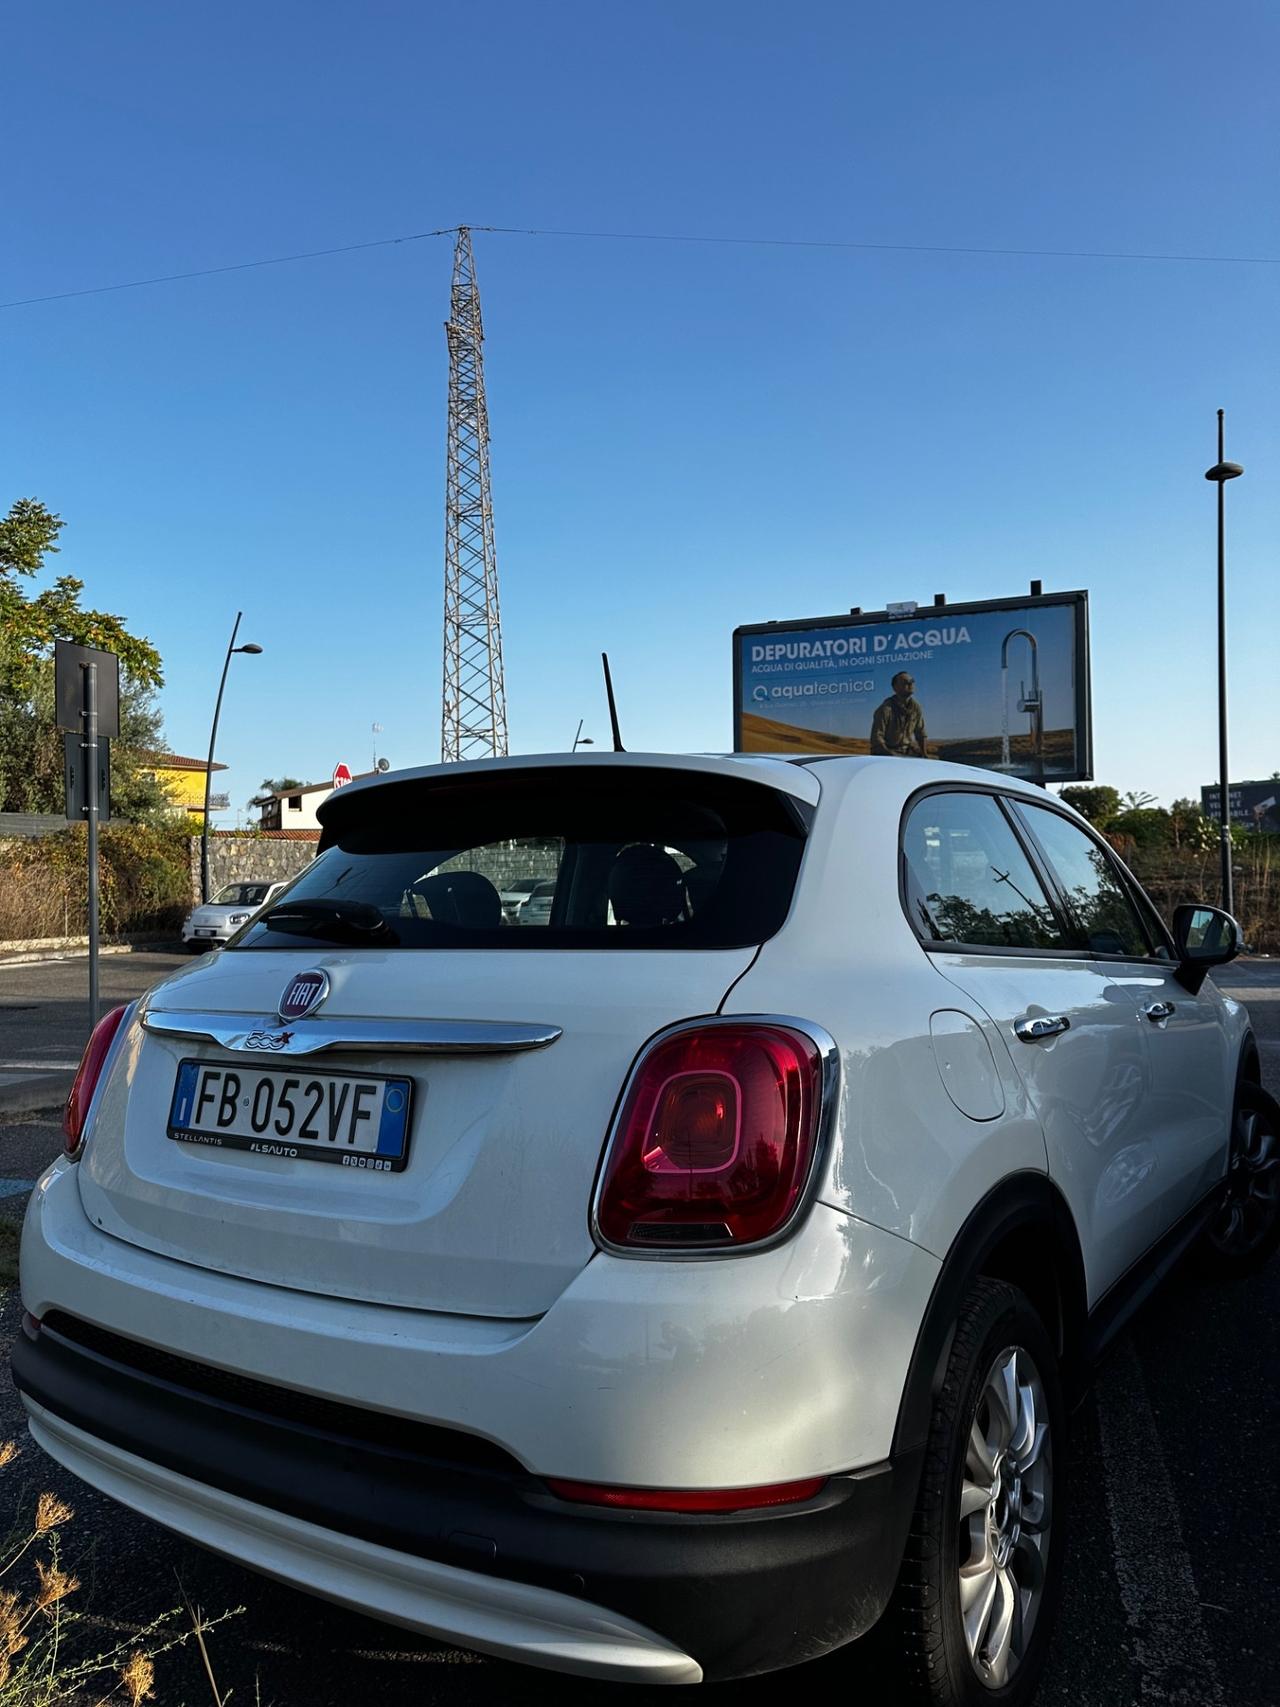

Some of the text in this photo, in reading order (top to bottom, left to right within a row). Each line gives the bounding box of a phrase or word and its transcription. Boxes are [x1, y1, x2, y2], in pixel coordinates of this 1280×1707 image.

[752, 627, 971, 662] DEPURATORI D'ACQUA
[752, 650, 934, 673] ACQUA DI QUALITÀ, IN OGNI SITUAZIONE
[771, 679, 875, 699] aquatecnica
[286, 982, 319, 1006] FIAT
[195, 1070, 378, 1145] FB 052VF
[174, 1132, 223, 1146] STELLANTIS
